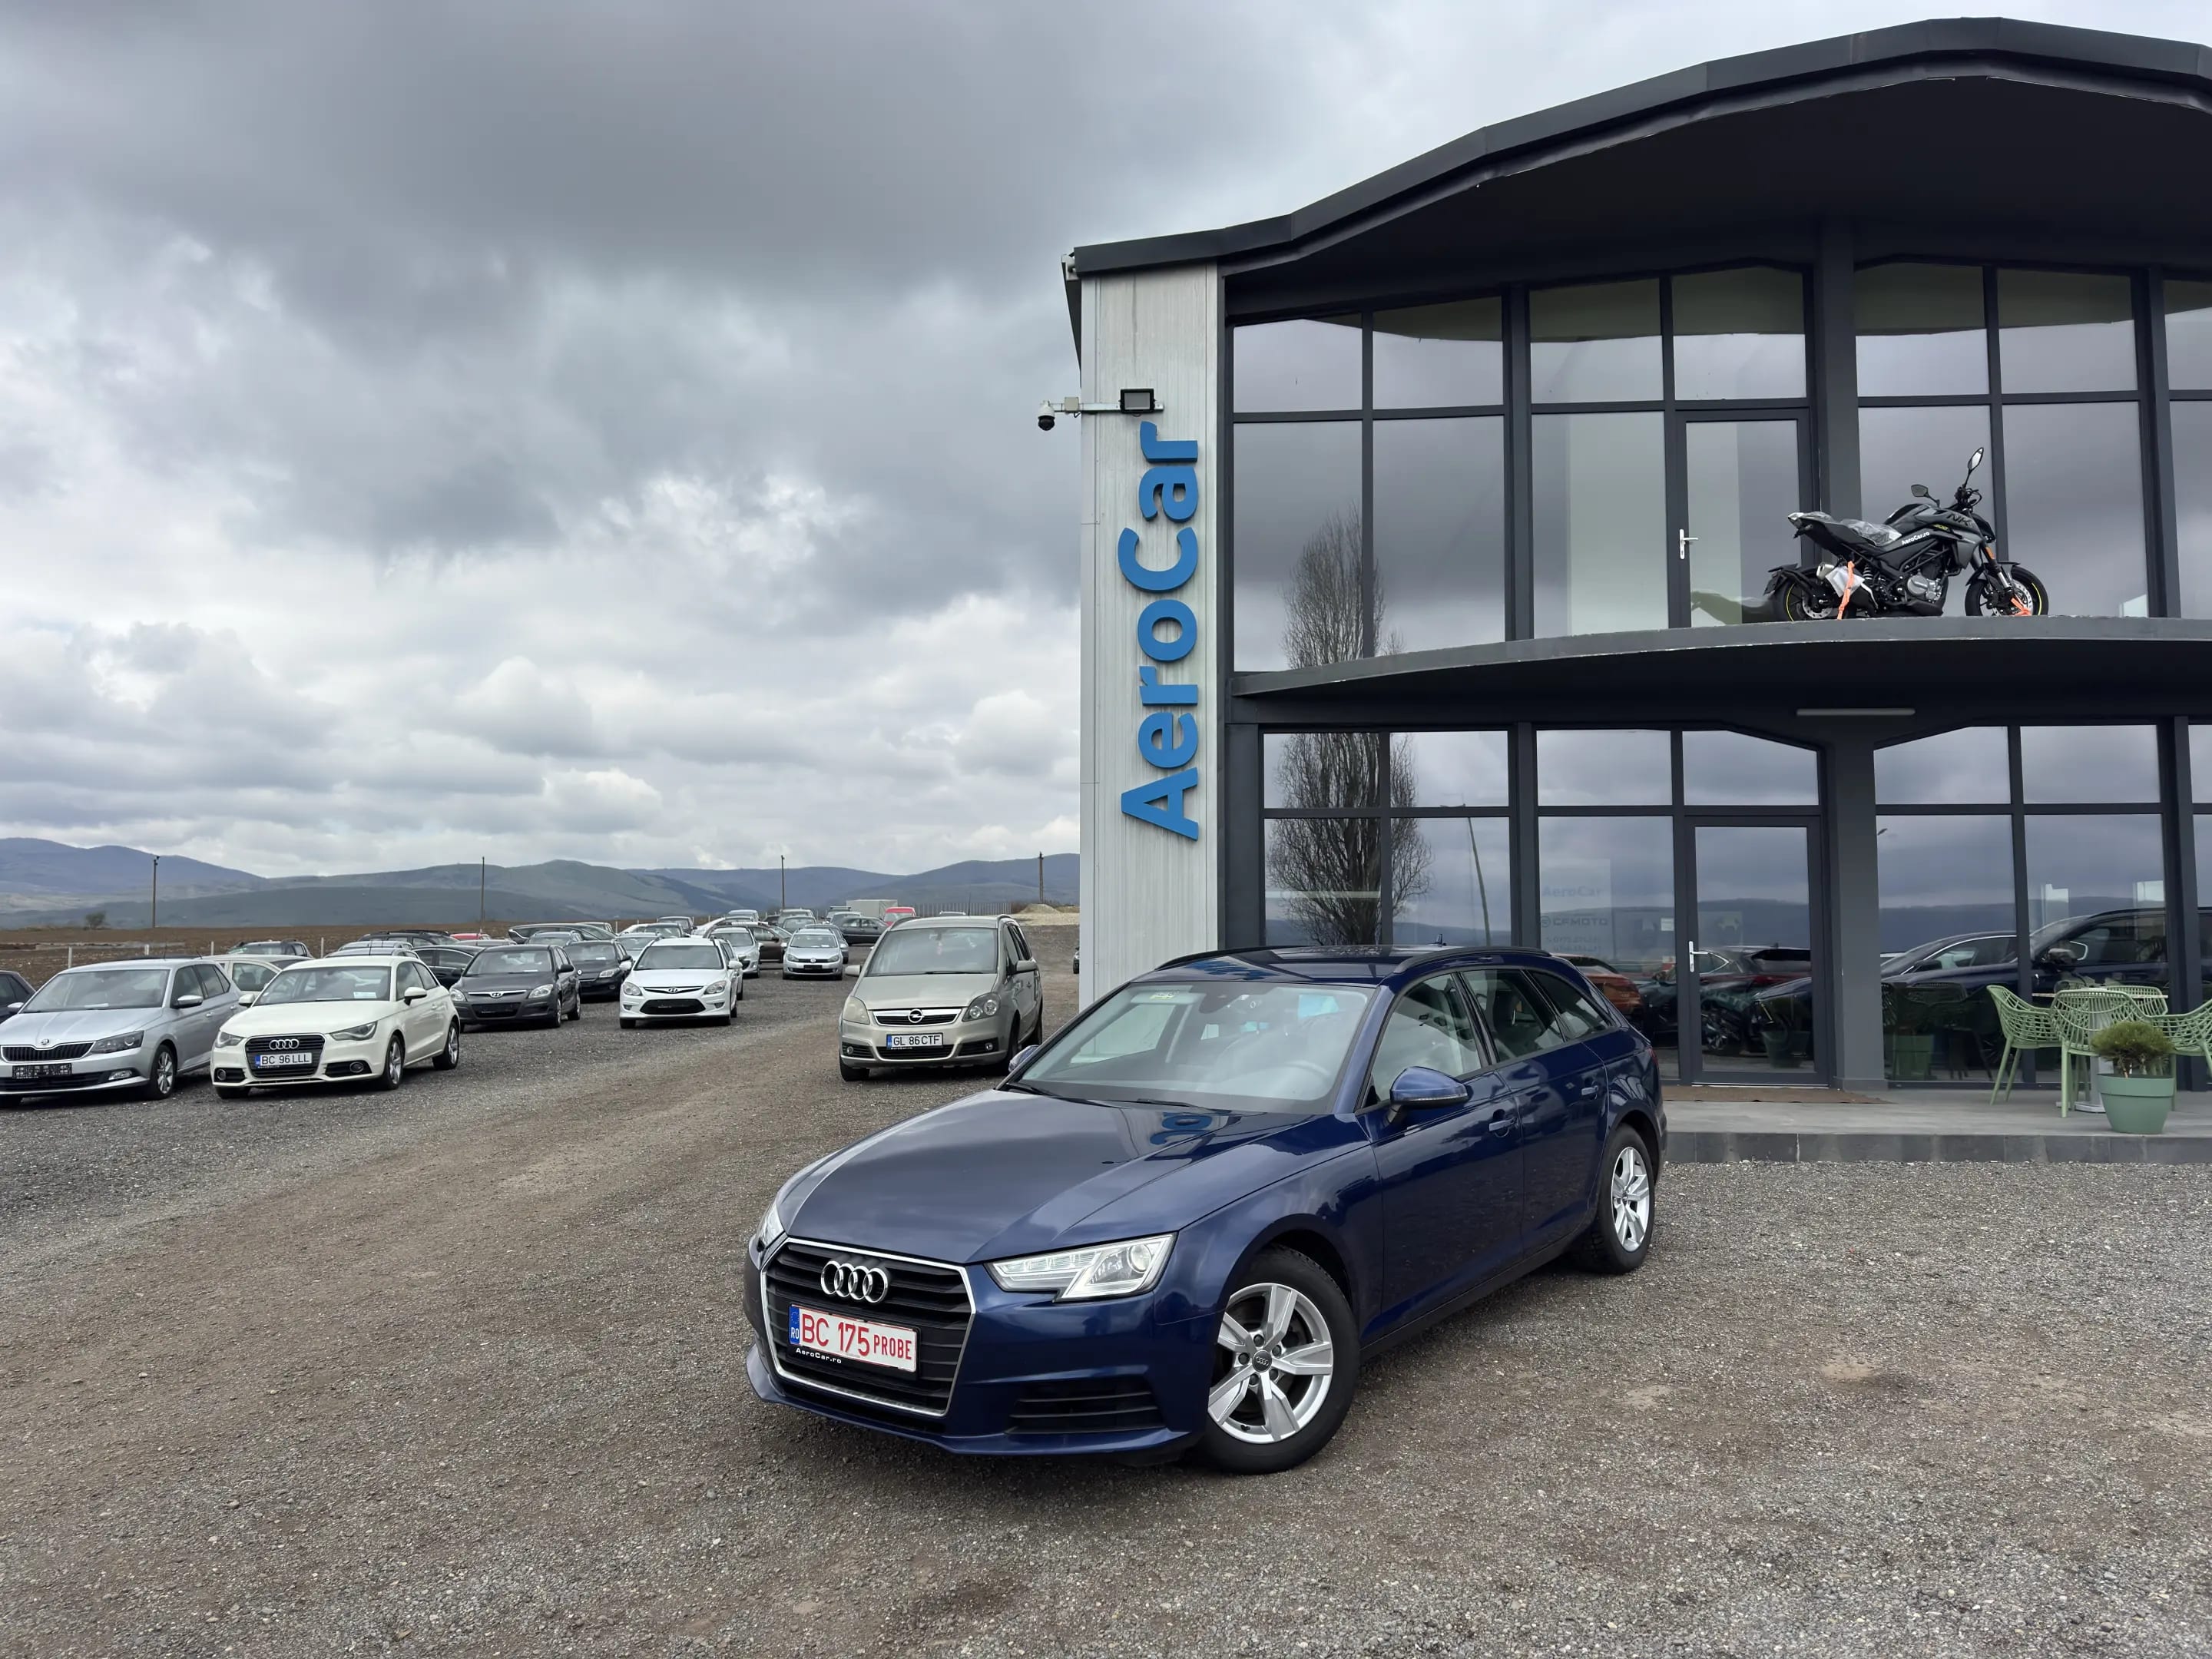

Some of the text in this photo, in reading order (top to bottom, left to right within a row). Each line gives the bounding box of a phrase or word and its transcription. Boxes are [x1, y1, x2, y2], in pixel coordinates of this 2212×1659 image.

[1901, 531, 1930, 545] AeroCar.ro
[1118, 421, 1199, 842] AeroCar
[1553, 917, 1608, 926] CFMOTO
[893, 1036, 906, 1045] GL
[262, 1053, 310, 1065] BC 96 LLL
[790, 1326, 800, 1339] RO
[801, 1313, 912, 1360] BC 175 PROBE
[795, 1347, 843, 1365] AeroCar.ro
